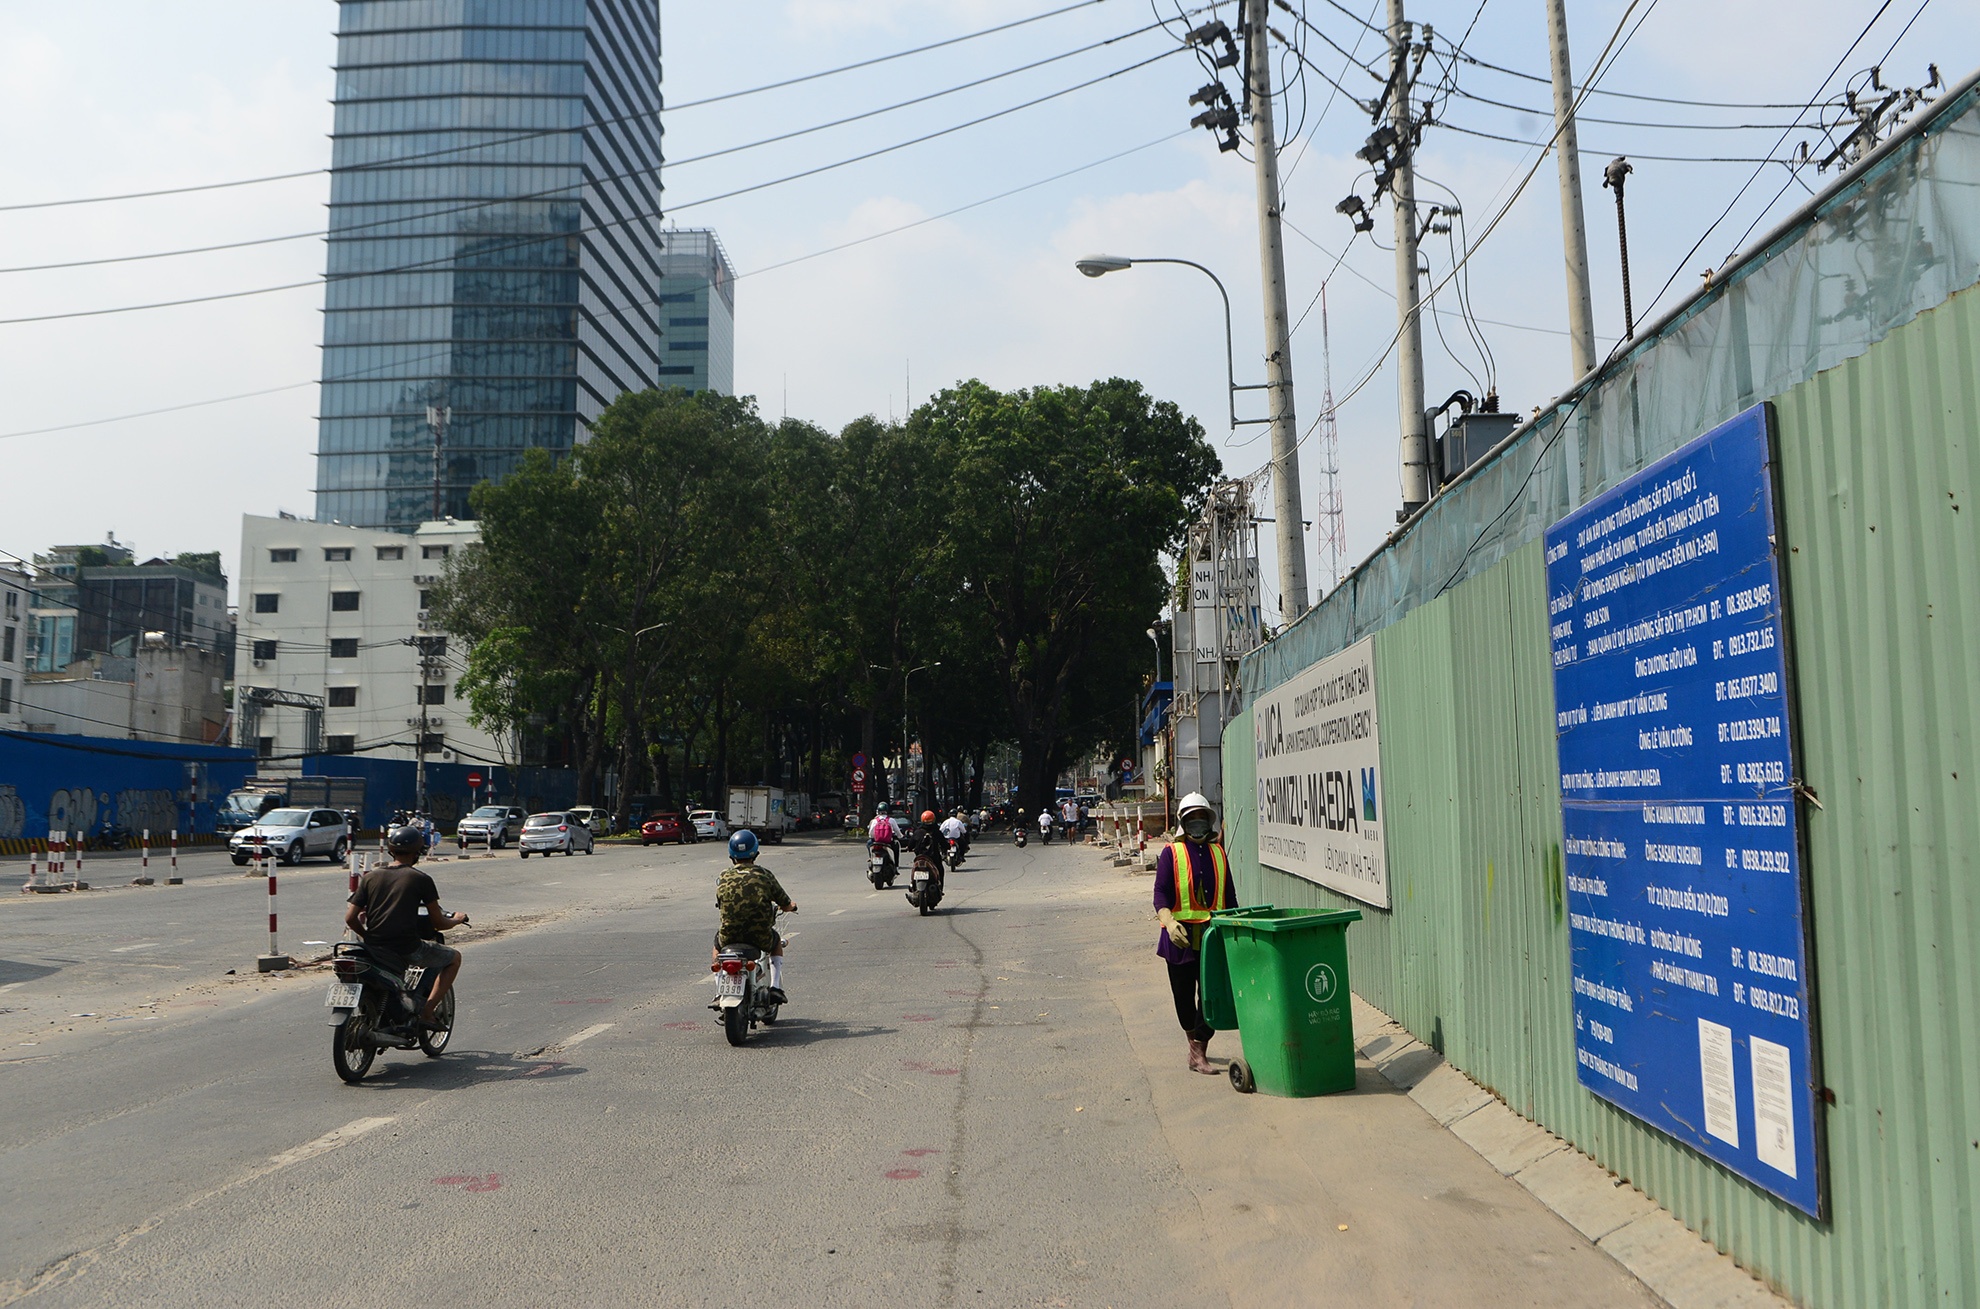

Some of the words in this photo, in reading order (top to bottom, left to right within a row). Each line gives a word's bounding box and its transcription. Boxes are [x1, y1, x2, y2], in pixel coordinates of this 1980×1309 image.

[1585, 525, 1593, 544] ÁN
[1592, 519, 1600, 540] XÂY
[1601, 514, 1615, 537] DỰNG
[1615, 501, 1631, 528] TUYẾN
[1632, 495, 1652, 520] ĐƯỜNG
[1652, 483, 1662, 510] SẮT
[1662, 480, 1672, 504] ĐÔ
[1671, 479, 1683, 500] THỊ
[1682, 466, 1691, 494] SỐ
[1692, 471, 1697, 489] 1
[1580, 553, 1596, 574] THÀNH
[1595, 543, 1605, 567] PHỐ
[1605, 540, 1613, 563] HỒ
[1613, 537, 1622, 559] CHÍ
[1637, 520, 1655, 548] TUYẾN
[1655, 514, 1667, 540] BẾN
[1666, 510, 1688, 534] THÀNH
[1688, 496, 1704, 525] SUỐI
[1703, 492, 1719, 518] TIÊN
[1583, 579, 1591, 601] XÂY
[1591, 578, 1605, 600] DỰNG
[1604, 572, 1620, 593] ĐOẠN
[1635, 558, 1645, 584] (TỪ
[1645, 557, 1656, 576] KM
[1655, 550, 1672, 572] 0+615
[1672, 539, 1685, 565] ĐẾN
[1685, 540, 1697, 560] KM
[1696, 529, 1718, 556] 2+360)
[1585, 613, 1593, 629] GA
[1592, 610, 1600, 626] BA
[1588, 639, 1598, 656] BAN
[1598, 630, 1612, 654] QUẢN
[1617, 629, 1625, 649] DỰ
[1626, 624, 1634, 644] ÁN
[1634, 619, 1654, 642] ĐƯỜNG
[1654, 611, 1664, 637] SẮT
[1665, 610, 1674, 633] ĐÔ
[1674, 612, 1685, 632] THỊ
[1684, 604, 1707, 627] TP.HCM
[1710, 600, 1721, 620] ĐT:
[1727, 584, 1771, 615] 08.3838.9495
[1635, 657, 1647, 678] ÔNG
[1647, 654, 1669, 675] DƯƠNG
[1669, 647, 1683, 670] HỮU
[1683, 643, 1697, 666] HÒA
[1713, 640, 1724, 660] ĐT:
[1729, 627, 1774, 656] 0913.732.165
[1592, 701, 1603, 721] LIÊN
[1602, 703, 1616, 719] DANH
[1628, 698, 1636, 715] TƯ
[1635, 691, 1648, 714] VẤN
[1648, 693, 1667, 712] CHUNG
[1716, 682, 1727, 701] ĐT:
[1728, 672, 1777, 699] 065.0377.3400
[1264, 702, 1284, 759] JICA
[1639, 729, 1651, 750] ÔNG
[1652, 727, 1658, 749] LÊ
[1657, 726, 1670, 748] VĂN
[1671, 724, 1692, 747] CƯỜNG
[1718, 723, 1729, 742] ĐT:
[1730, 716, 1780, 741] 0120.3394.744
[1595, 768, 1606, 788] LIÊN
[1606, 772, 1620, 787] DANH
[1620, 769, 1661, 787] SHIMIZU-MAEDA
[1721, 764, 1732, 784] ĐT:
[1737, 761, 1784, 783] 08.3825.6163
[1266, 770, 1358, 834] SHIMIZU-MAEDA
[1641, 801, 1655, 823] ÔNG
[1655, 806, 1674, 824] KAWAI
[1674, 806, 1705, 824] NOBUYUKI
[1723, 806, 1735, 825] ĐT:
[1739, 805, 1786, 826] 0916.329.620
[1645, 839, 1658, 861] ÔNG
[1657, 844, 1677, 863] SASAKI
[1677, 846, 1702, 865] SUGURU
[1726, 848, 1737, 868] ĐT:
[1742, 849, 1790, 873] 0938.239.922
[1647, 883, 1655, 904] TỪ
[1655, 887, 1684, 910] 21/8/2014
[1684, 885, 1697, 911] ĐẾN
[1697, 893, 1728, 918] 20/2/2019
[1651, 927, 1672, 951] ĐƯỜNG
[1672, 930, 1683, 954] DÂY
[1683, 933, 1702, 959] NÓNG
[1731, 947, 1744, 968] ĐT:
[1748, 950, 1797, 981] 08.3830.0701
[719, 985, 742, 994] 0390
[1652, 958, 1665, 980] PHÓ
[1664, 961, 1684, 986] CHÁNH
[1683, 969, 1705, 992] THANH
[1705, 974, 1719, 996] TRA
[1733, 982, 1746, 1004] ĐT:
[1750, 986, 1799, 1020] 0903.812.723
